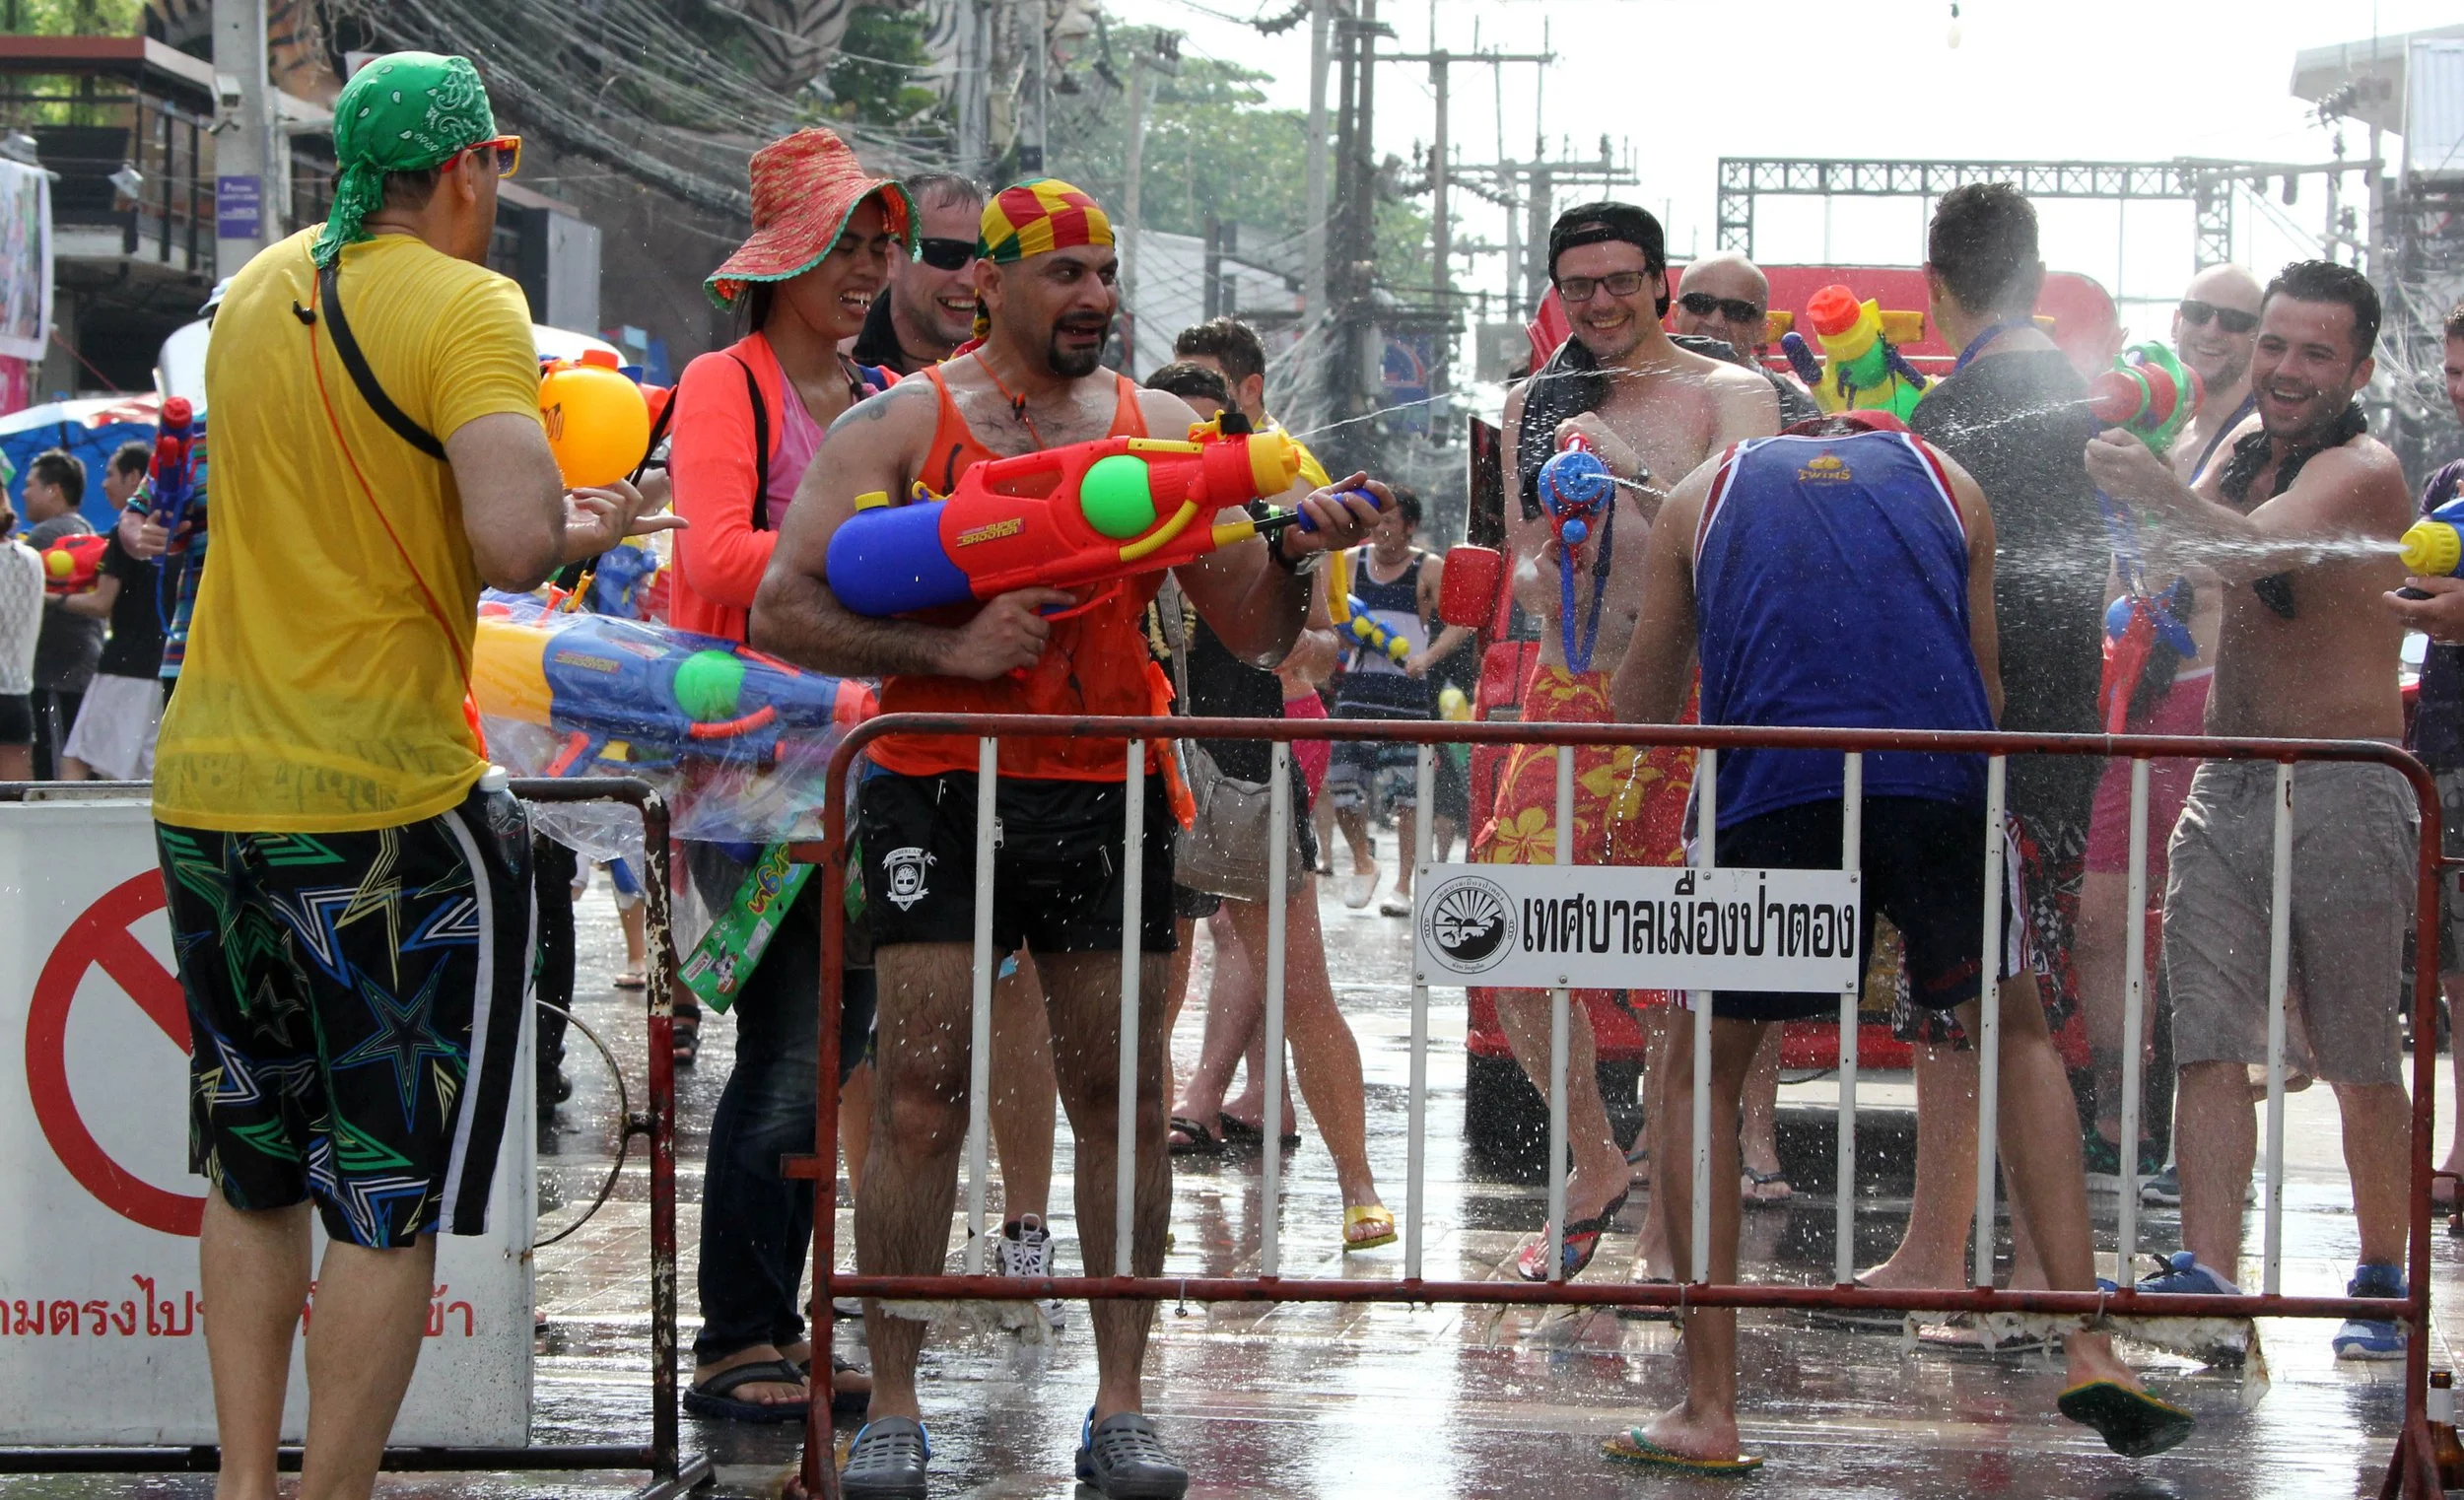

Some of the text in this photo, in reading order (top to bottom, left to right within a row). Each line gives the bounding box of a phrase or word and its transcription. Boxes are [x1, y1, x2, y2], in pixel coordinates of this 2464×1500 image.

[986, 517, 1021, 533] SUPER
[957, 526, 1017, 547] SHOOTER
[1524, 870, 1854, 958] เทศบาลเมืองป่าตอง
